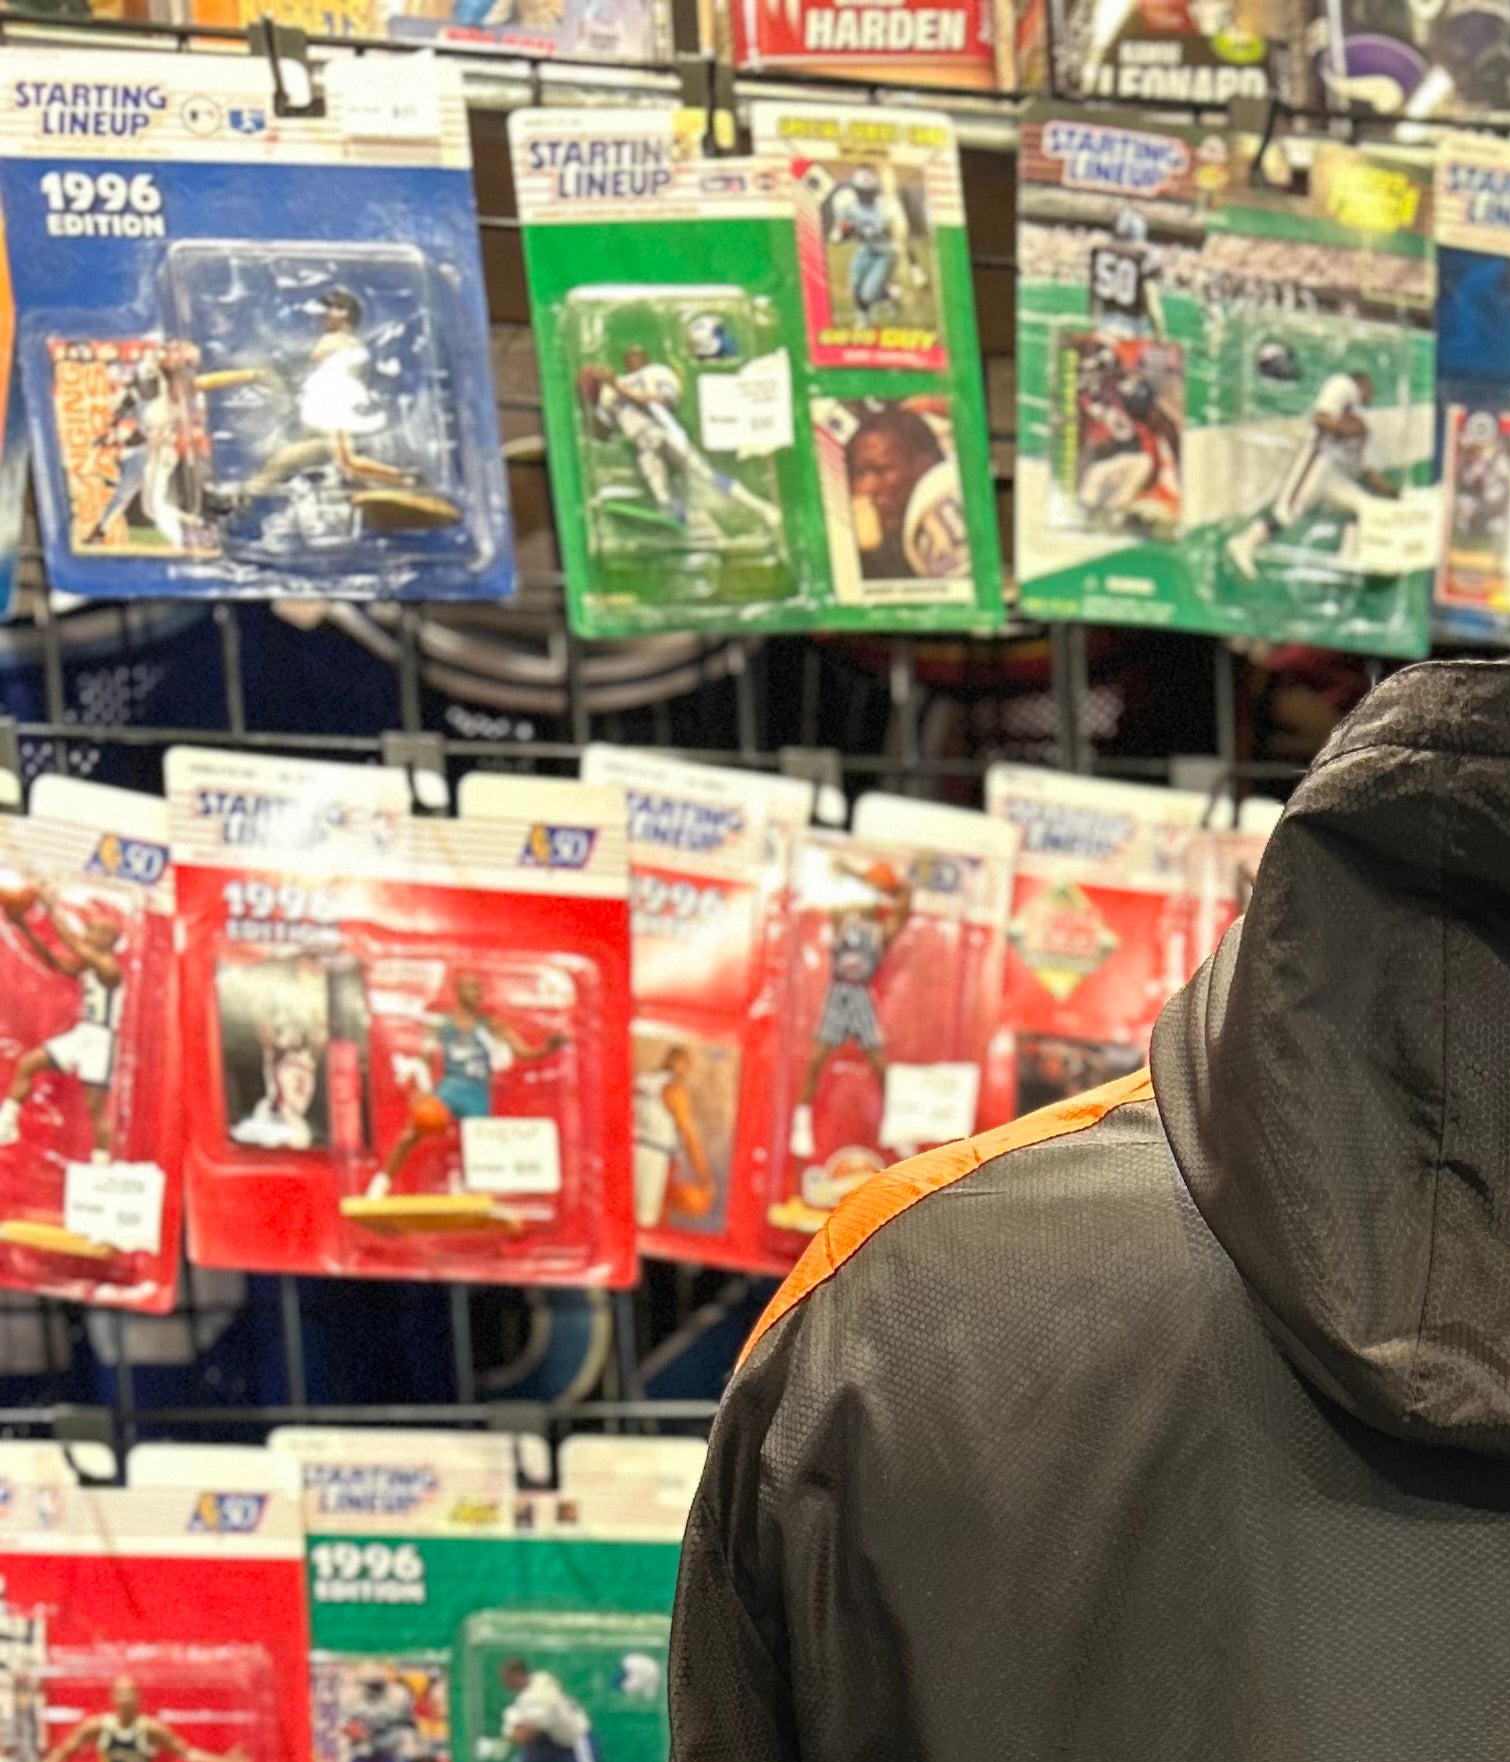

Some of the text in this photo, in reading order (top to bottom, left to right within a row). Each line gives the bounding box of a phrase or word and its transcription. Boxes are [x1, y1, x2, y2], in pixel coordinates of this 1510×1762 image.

[804, 9, 966, 50] HARDEN
[15, 82, 167, 110] STARTING
[42, 110, 150, 137] LINEUP
[529, 139, 663, 169] STARTIN
[1050, 127, 1186, 170] STARTING
[556, 169, 672, 199] LINEUP
[1070, 155, 1166, 189] LINEUP
[40, 172, 162, 213] 1996
[47, 213, 165, 238] EDITION
[1094, 250, 1138, 306] 50
[311, 1542, 425, 1581] 1996
[314, 1579, 426, 1604] EDITION
